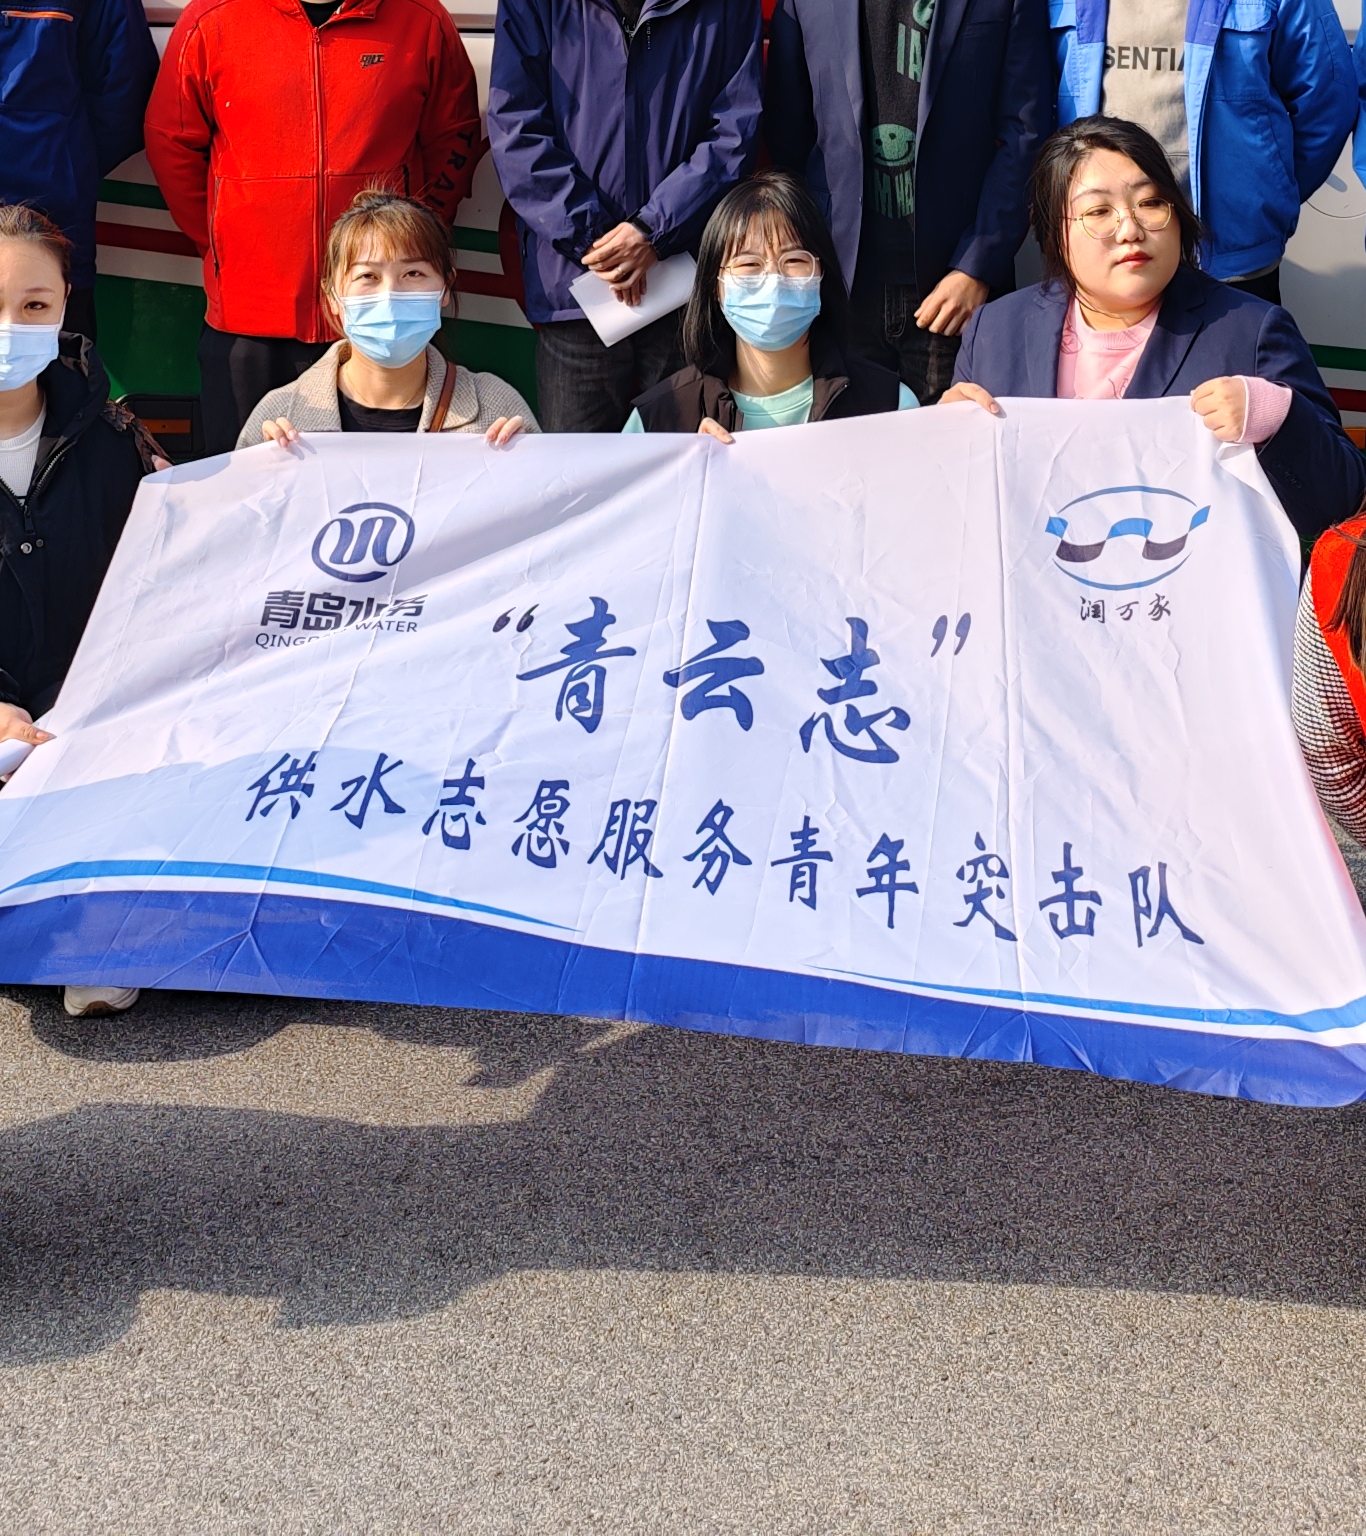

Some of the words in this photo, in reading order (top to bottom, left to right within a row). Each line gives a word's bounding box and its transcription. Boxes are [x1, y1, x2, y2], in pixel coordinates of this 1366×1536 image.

[355, 620, 418, 633] WATER
[245, 752, 1206, 946] 供水志愿服务青年突击队
